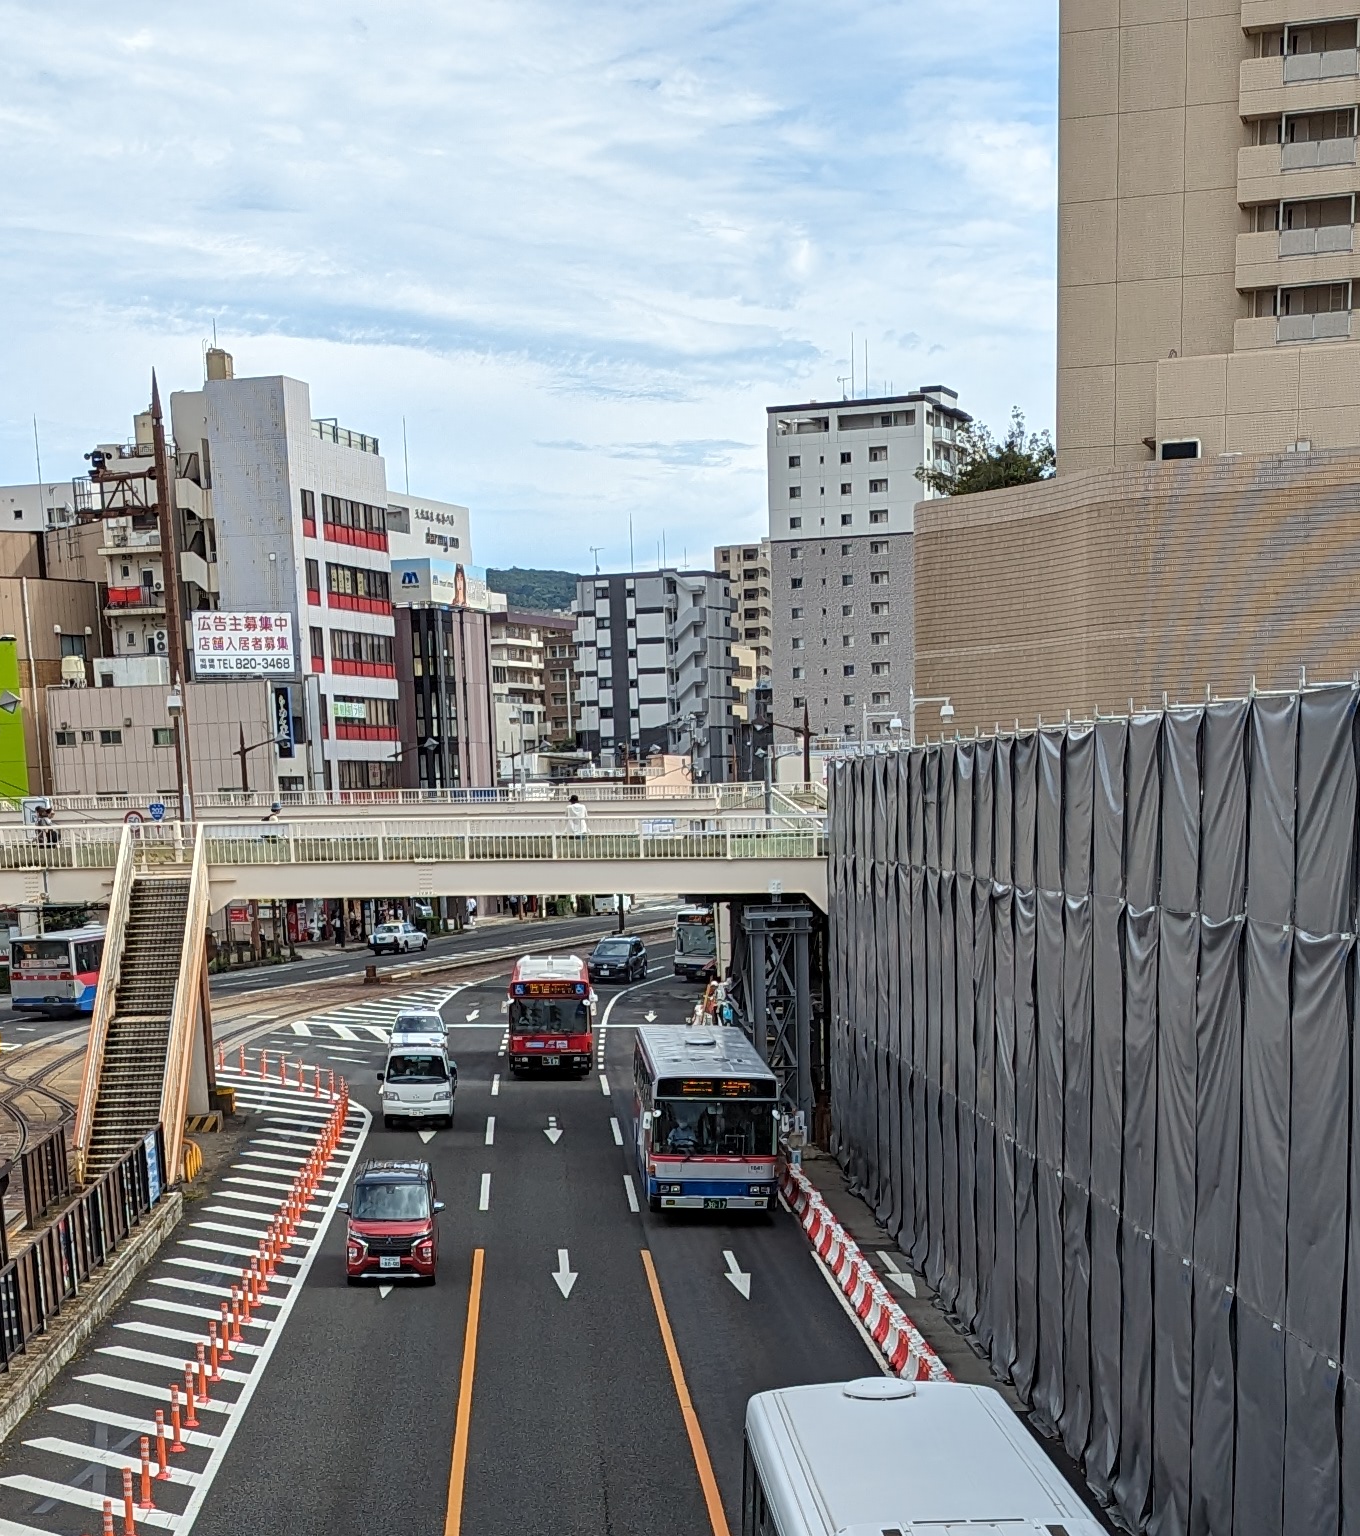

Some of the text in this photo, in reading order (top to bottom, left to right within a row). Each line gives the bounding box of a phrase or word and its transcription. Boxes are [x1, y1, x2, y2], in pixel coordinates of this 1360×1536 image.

[197, 615, 288, 633] 広告主募集中
[198, 636, 289, 651] 店舗入居者募集
[216, 658, 234, 669] TEL
[235, 657, 291, 670] 820-3468
[151, 807, 163, 815] 202
